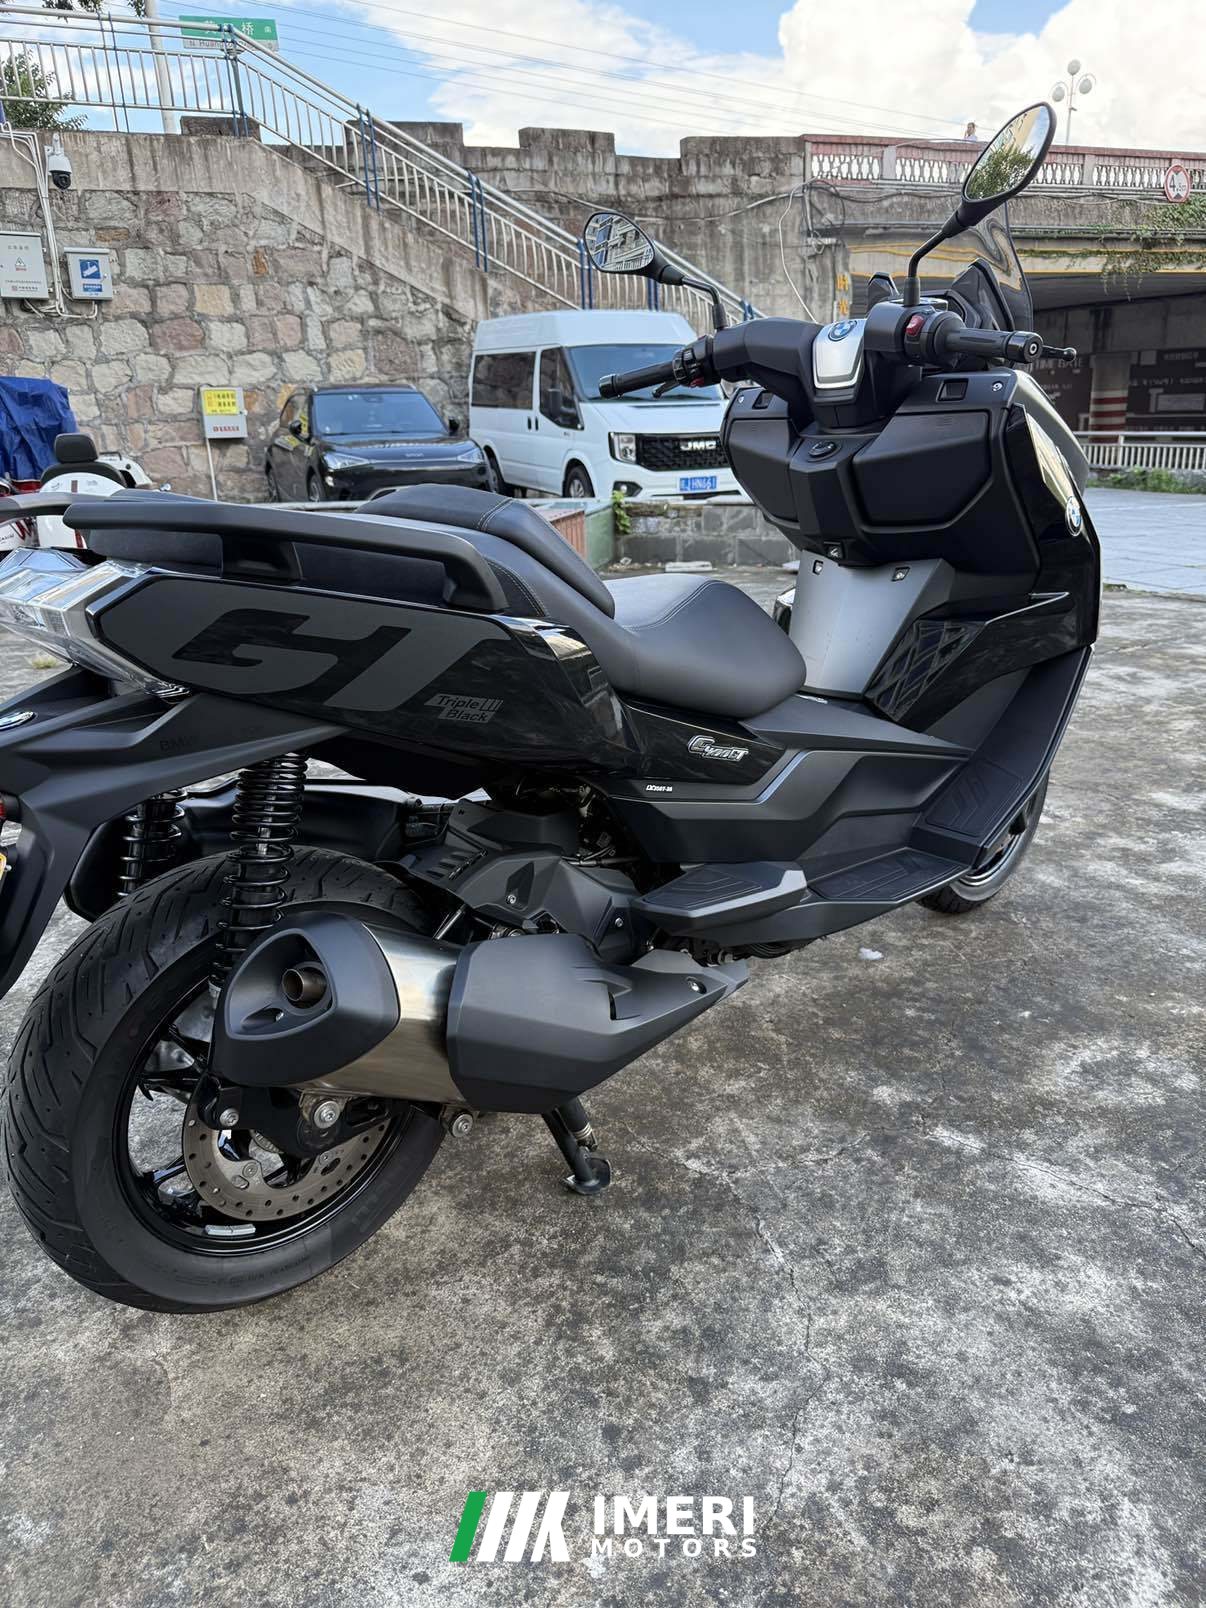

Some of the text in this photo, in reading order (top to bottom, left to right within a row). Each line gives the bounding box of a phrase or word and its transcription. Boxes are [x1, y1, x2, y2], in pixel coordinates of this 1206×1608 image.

[680, 440, 717, 451] JMC
[436, 694, 480, 709] Triple
[447, 709, 487, 722] Black
